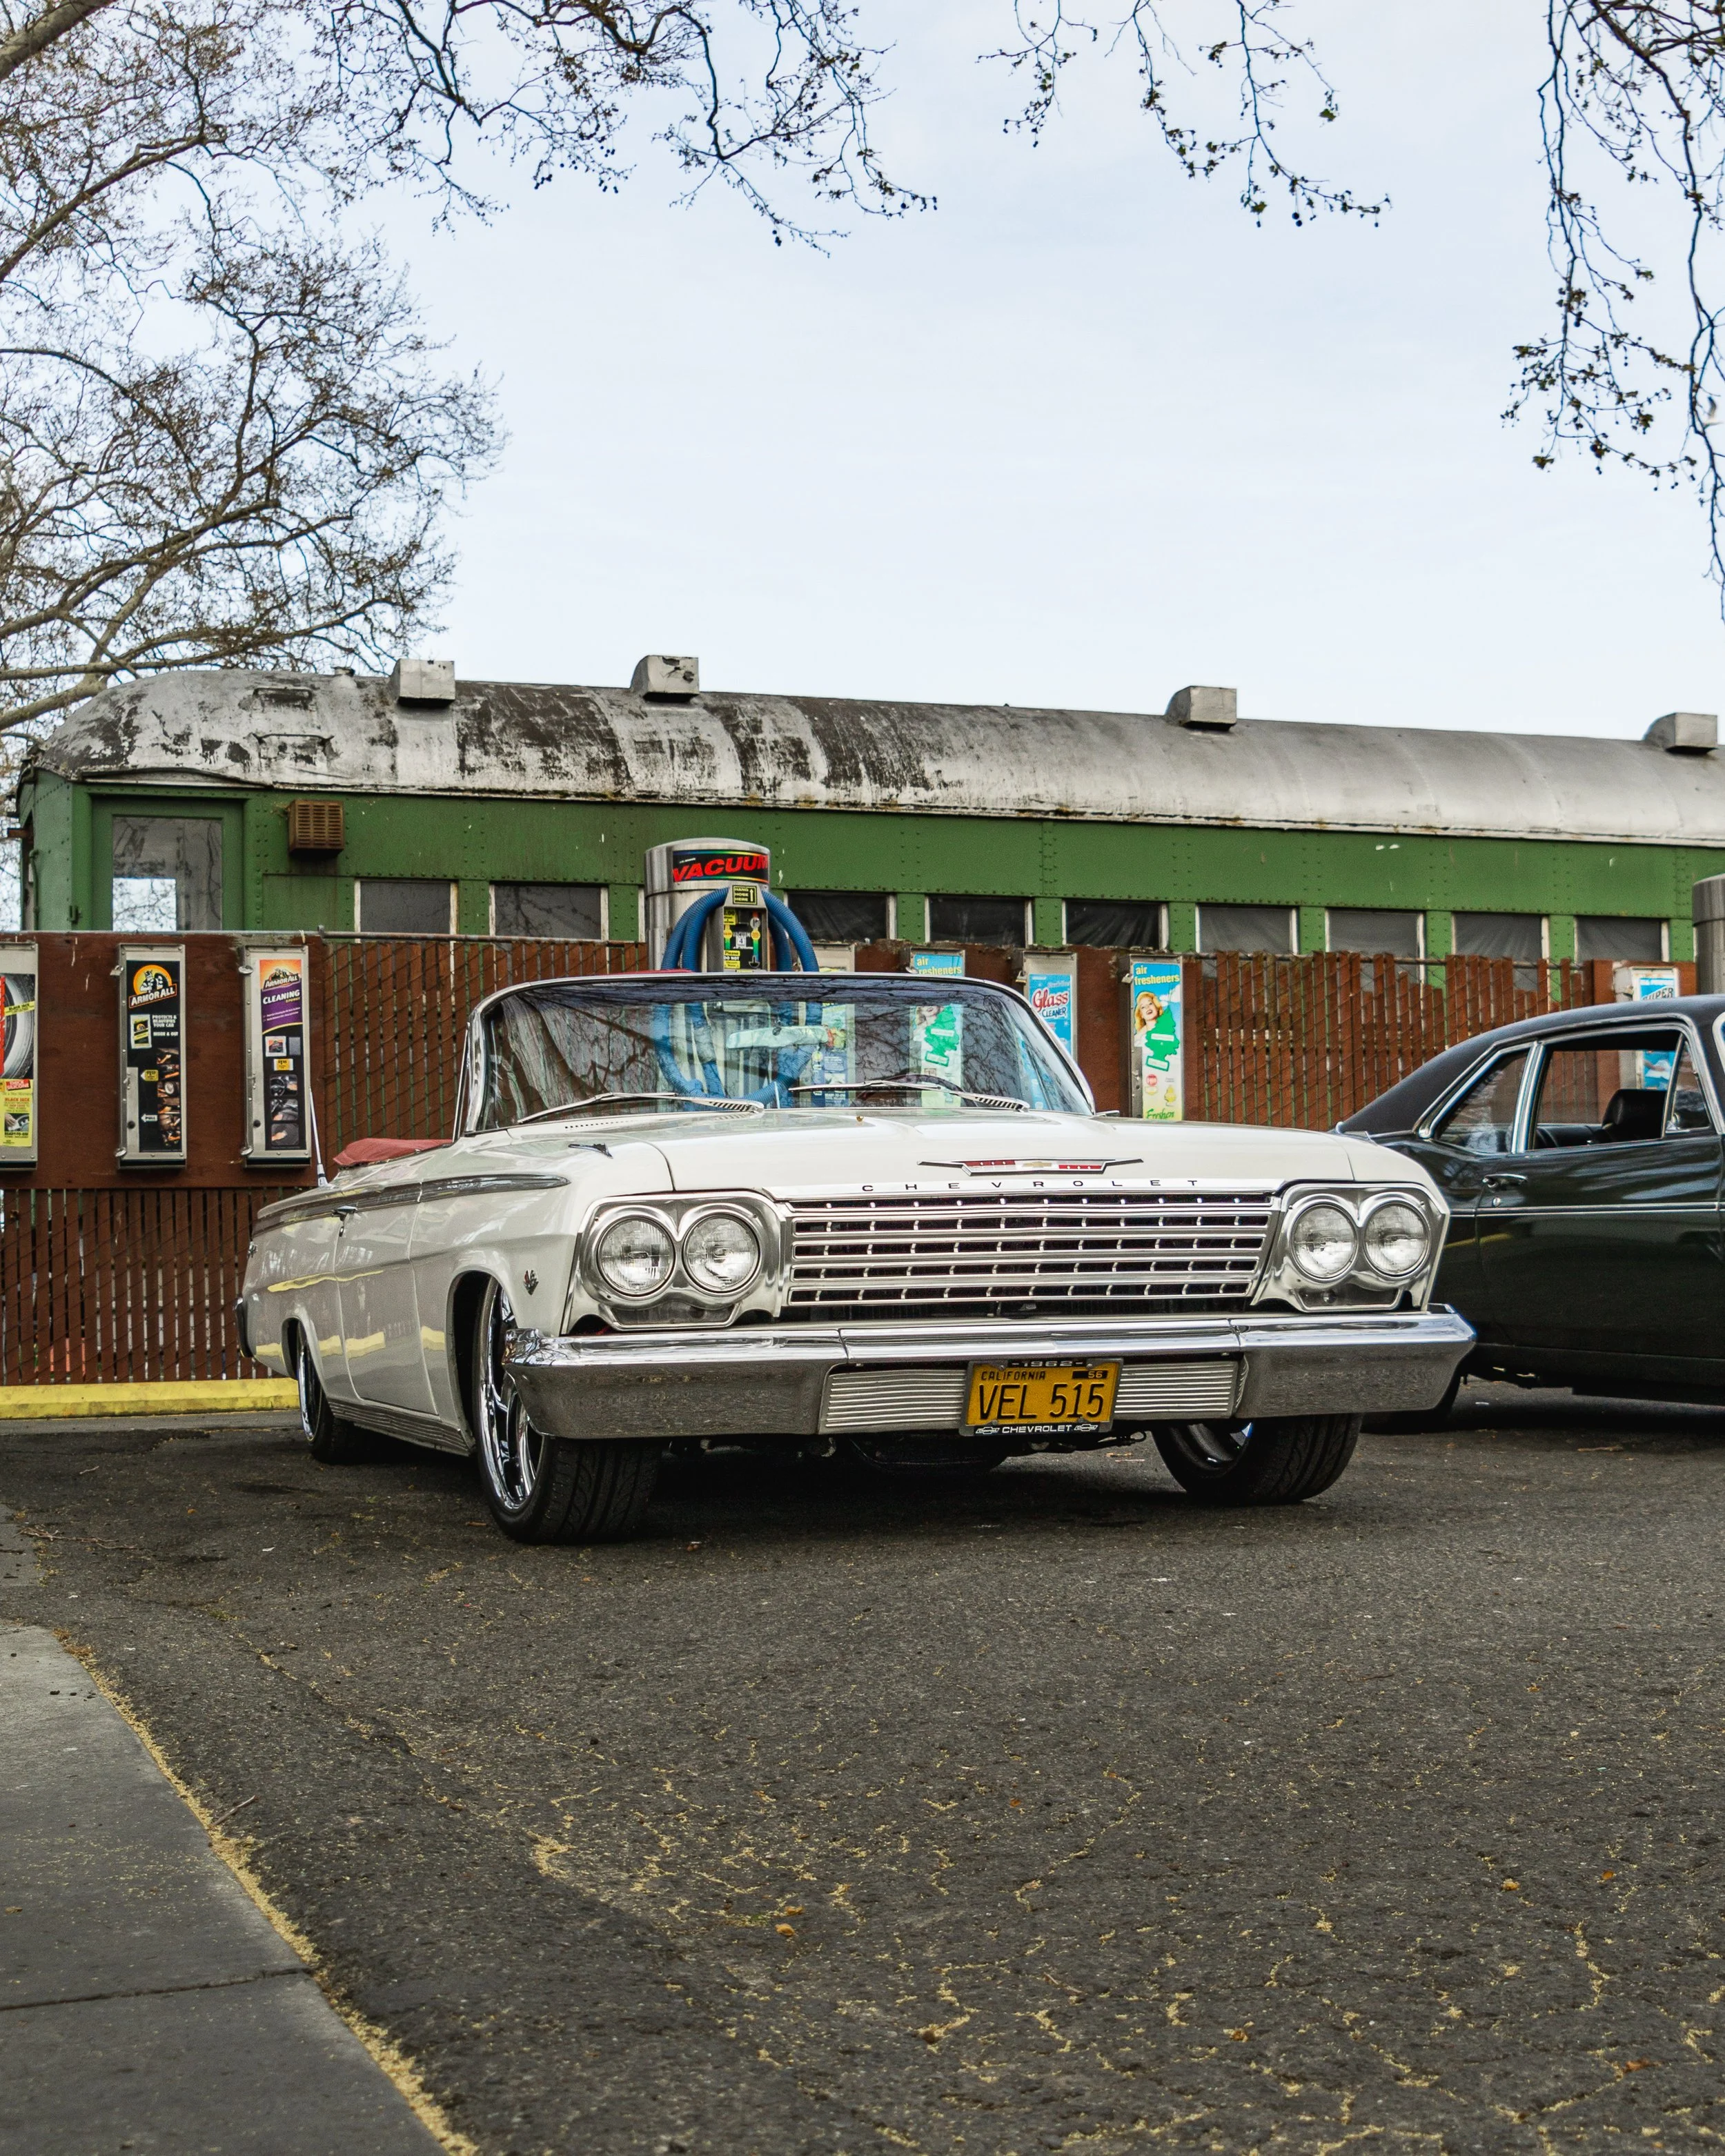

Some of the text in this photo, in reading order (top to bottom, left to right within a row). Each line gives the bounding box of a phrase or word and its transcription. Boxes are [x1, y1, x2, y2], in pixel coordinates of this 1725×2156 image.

[672, 855, 768, 882] VACUUM
[917, 957, 929, 966] air
[917, 966, 962, 975] resheners
[1136, 965, 1147, 975] air
[1134, 975, 1179, 985] fresheners
[263, 989, 300, 1005] CLEANING
[1032, 988, 1069, 1012] Glass
[1042, 1007, 1067, 1018] CLEANER
[862, 1179, 1199, 1192] CHEVROLET
[980, 1371, 1046, 1381] CALIFORNIA
[979, 1383, 1105, 1419] VEL 515
[1002, 1424, 1072, 1434] CHEVROLET
